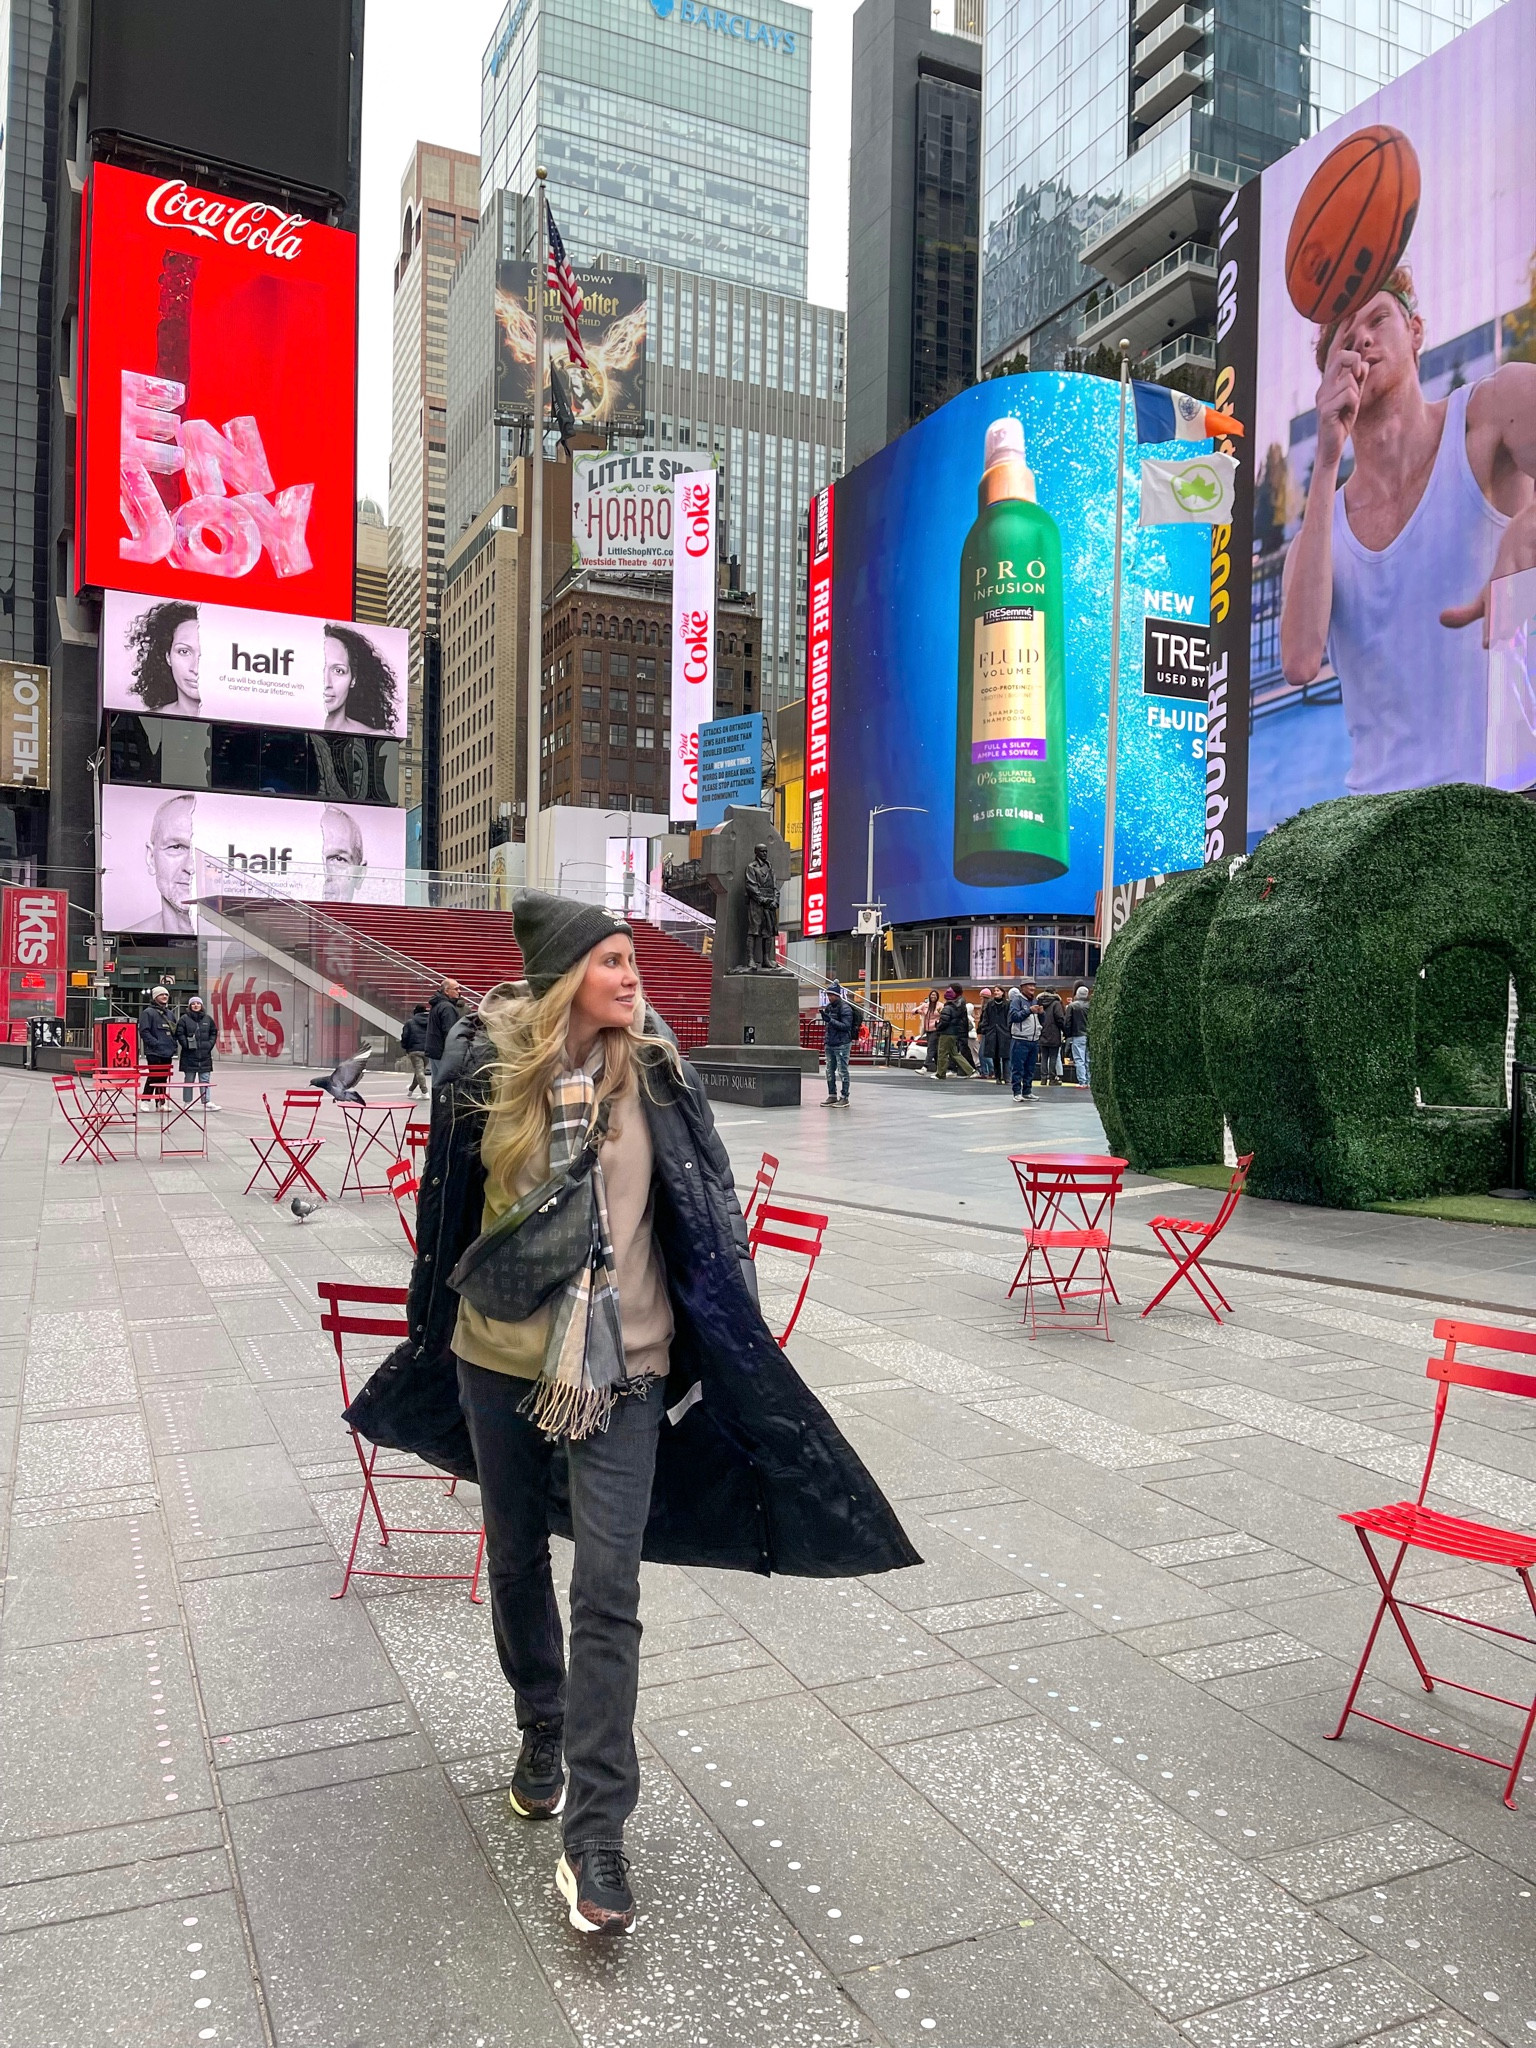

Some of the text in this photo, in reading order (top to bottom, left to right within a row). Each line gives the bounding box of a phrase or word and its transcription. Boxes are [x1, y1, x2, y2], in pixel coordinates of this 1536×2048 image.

[680, 0, 796, 54] BARCLAYS
[575, 274, 614, 284] ADWAY
[543, 314, 564, 323] CURS
[588, 457, 653, 492] LITTLE
[637, 484, 651, 493] OF
[587, 497, 671, 556] HORRO
[681, 484, 710, 557] Diet Coke
[608, 547, 673, 557] LittleShopNYC.co
[581, 558, 616, 566] Westside
[618, 558, 647, 567] Theatre
[975, 560, 1046, 586] PRO
[973, 582, 1045, 601] INFUSION
[1144, 589, 1194, 614] NEW
[985, 607, 1033, 618] TRESemmé
[680, 610, 708, 684] Diet Coke
[1151, 632, 1210, 671] TRE
[232, 643, 294, 676] half
[980, 649, 1039, 668] FLUID
[811, 577, 830, 777] FREE CHOCOLATE
[983, 668, 1031, 678] VOLUME
[1157, 672, 1205, 688] USED BY
[228, 684, 250, 692] cancer
[257, 679, 290, 689] diagnosed
[1204, 524, 1231, 864] SQUARE JUS
[989, 709, 1024, 717] SHAMPOO
[1147, 706, 1208, 733] FLUID
[13, 671, 39, 782] HELLO!
[703, 727, 722, 737] ATTACKS
[729, 721, 753, 732] ORTHODOX
[678, 733, 688, 759] Diet
[703, 732, 752, 747] JEWS HAVE MORE THAN
[984, 743, 1000, 751] FULL
[703, 747, 722, 757] DOUBLED
[977, 750, 1000, 759] AMPLE
[1191, 738, 1207, 760] S
[702, 773, 717, 781] WORDS
[725, 769, 739, 778] BREAK
[977, 770, 997, 786] 0%
[998, 776, 1036, 784] SILICONES
[702, 777, 754, 792] PLEASE STOP ATTACKING
[996, 809, 1003, 817] FL
[1005, 808, 1013, 817] OZ
[812, 799, 823, 867] HERSHEY'S
[228, 844, 292, 875] half
[18, 896, 57, 964] tkts
[211, 973, 284, 1058] tkts
[710, 1074, 729, 1086] DUFFY
[731, 1075, 757, 1090] SQUARE
